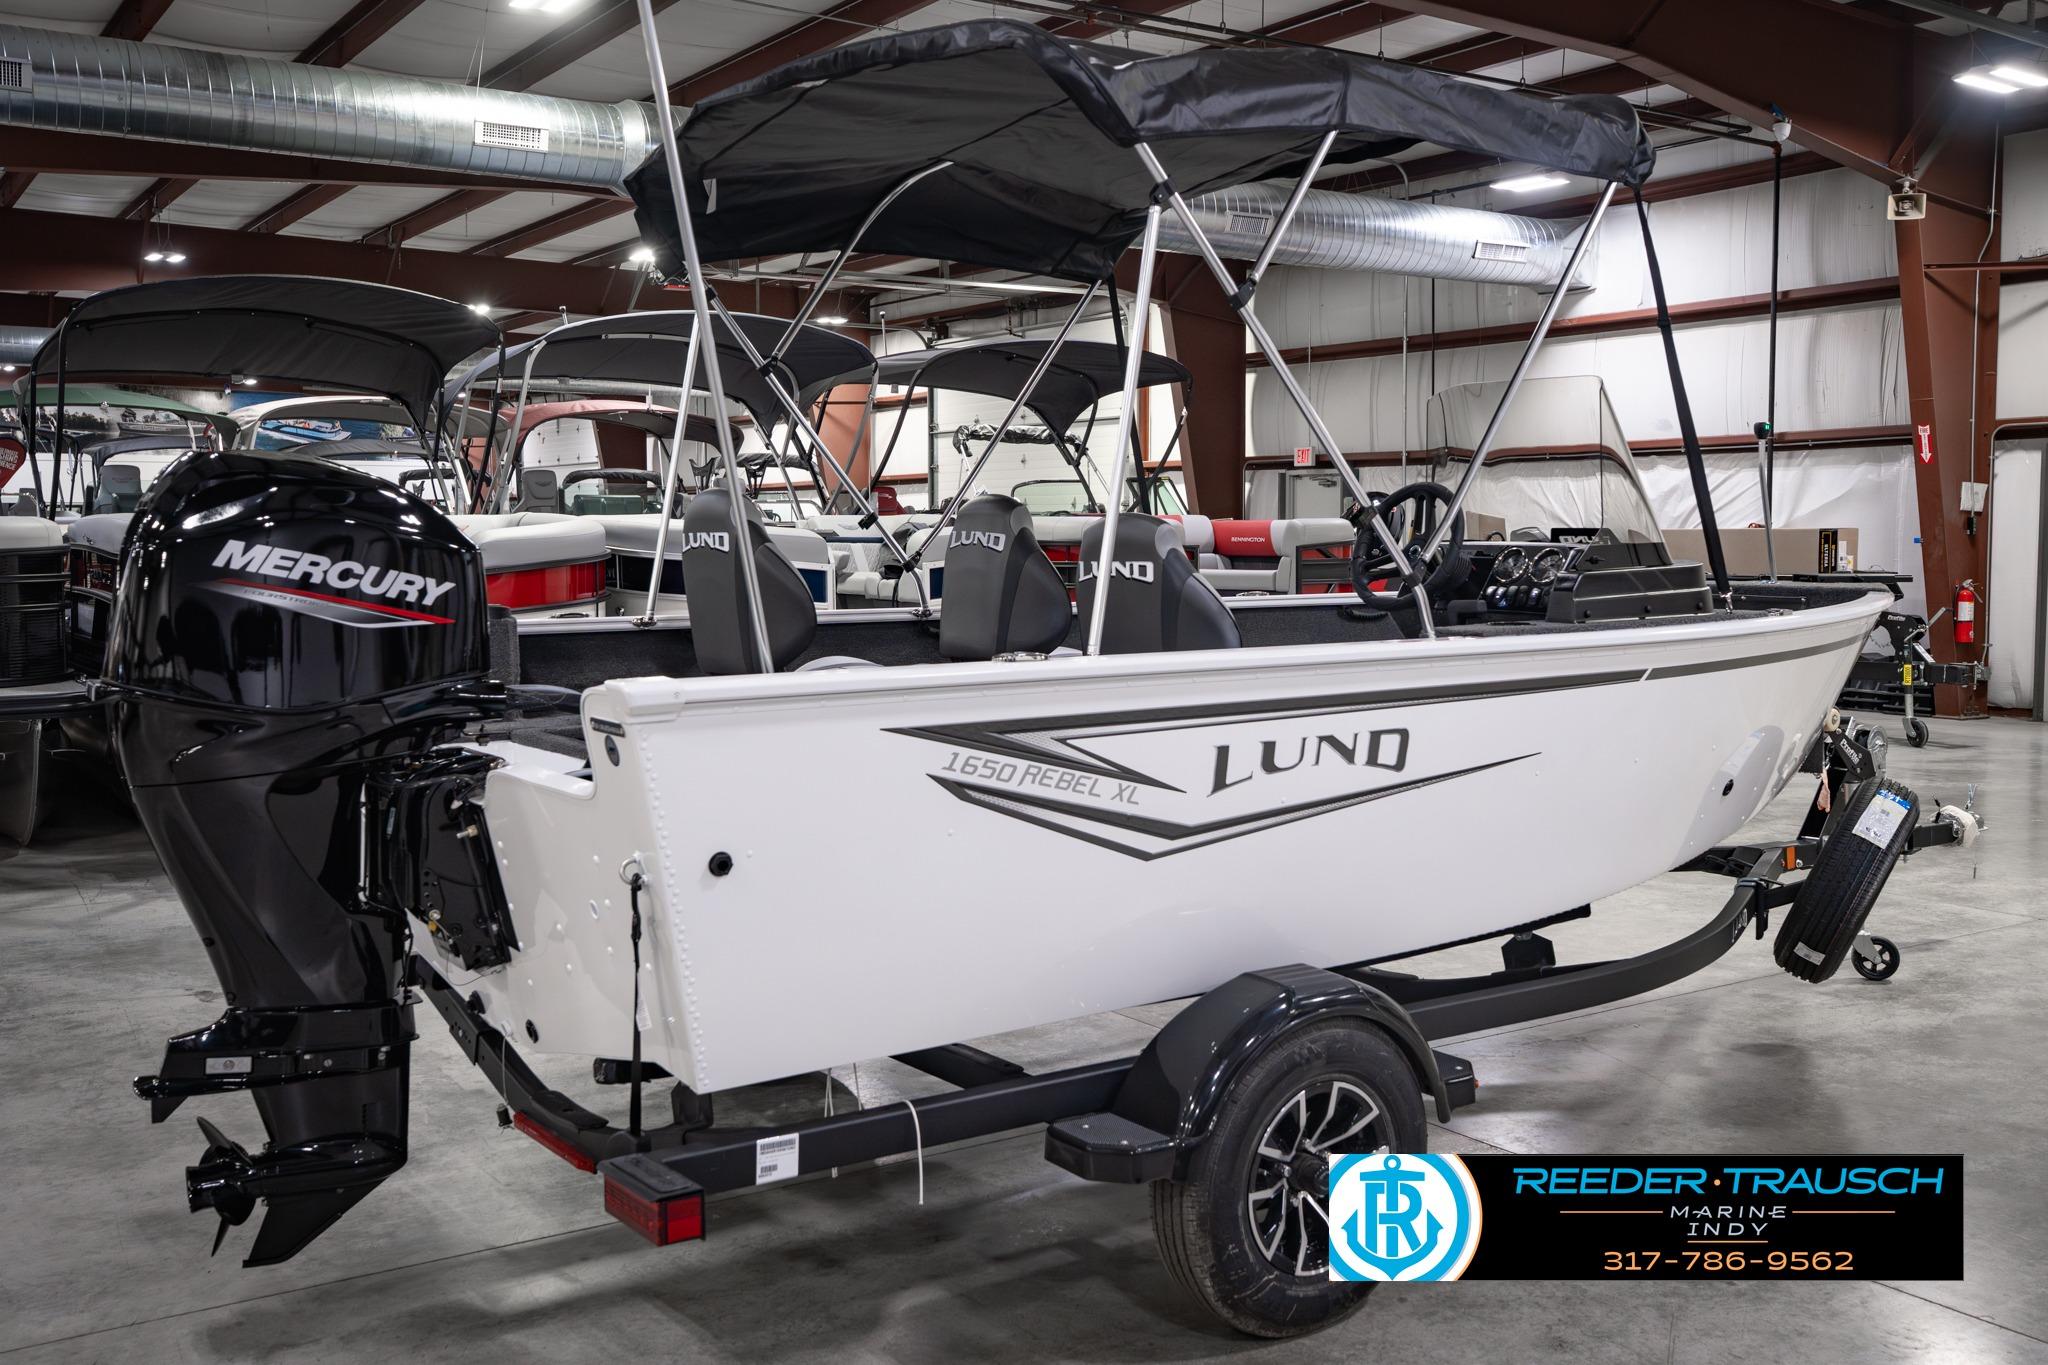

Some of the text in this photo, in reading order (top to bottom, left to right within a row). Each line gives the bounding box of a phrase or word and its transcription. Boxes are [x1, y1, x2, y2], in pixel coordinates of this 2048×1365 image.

[1297, 449, 1311, 463] EXIT
[682, 532, 730, 552] LUND
[950, 531, 1006, 551] LUND
[212, 539, 456, 606] MERCURY
[942, 752, 1140, 805] 1650 REBEL XL
[1207, 728, 1409, 798] LUND
